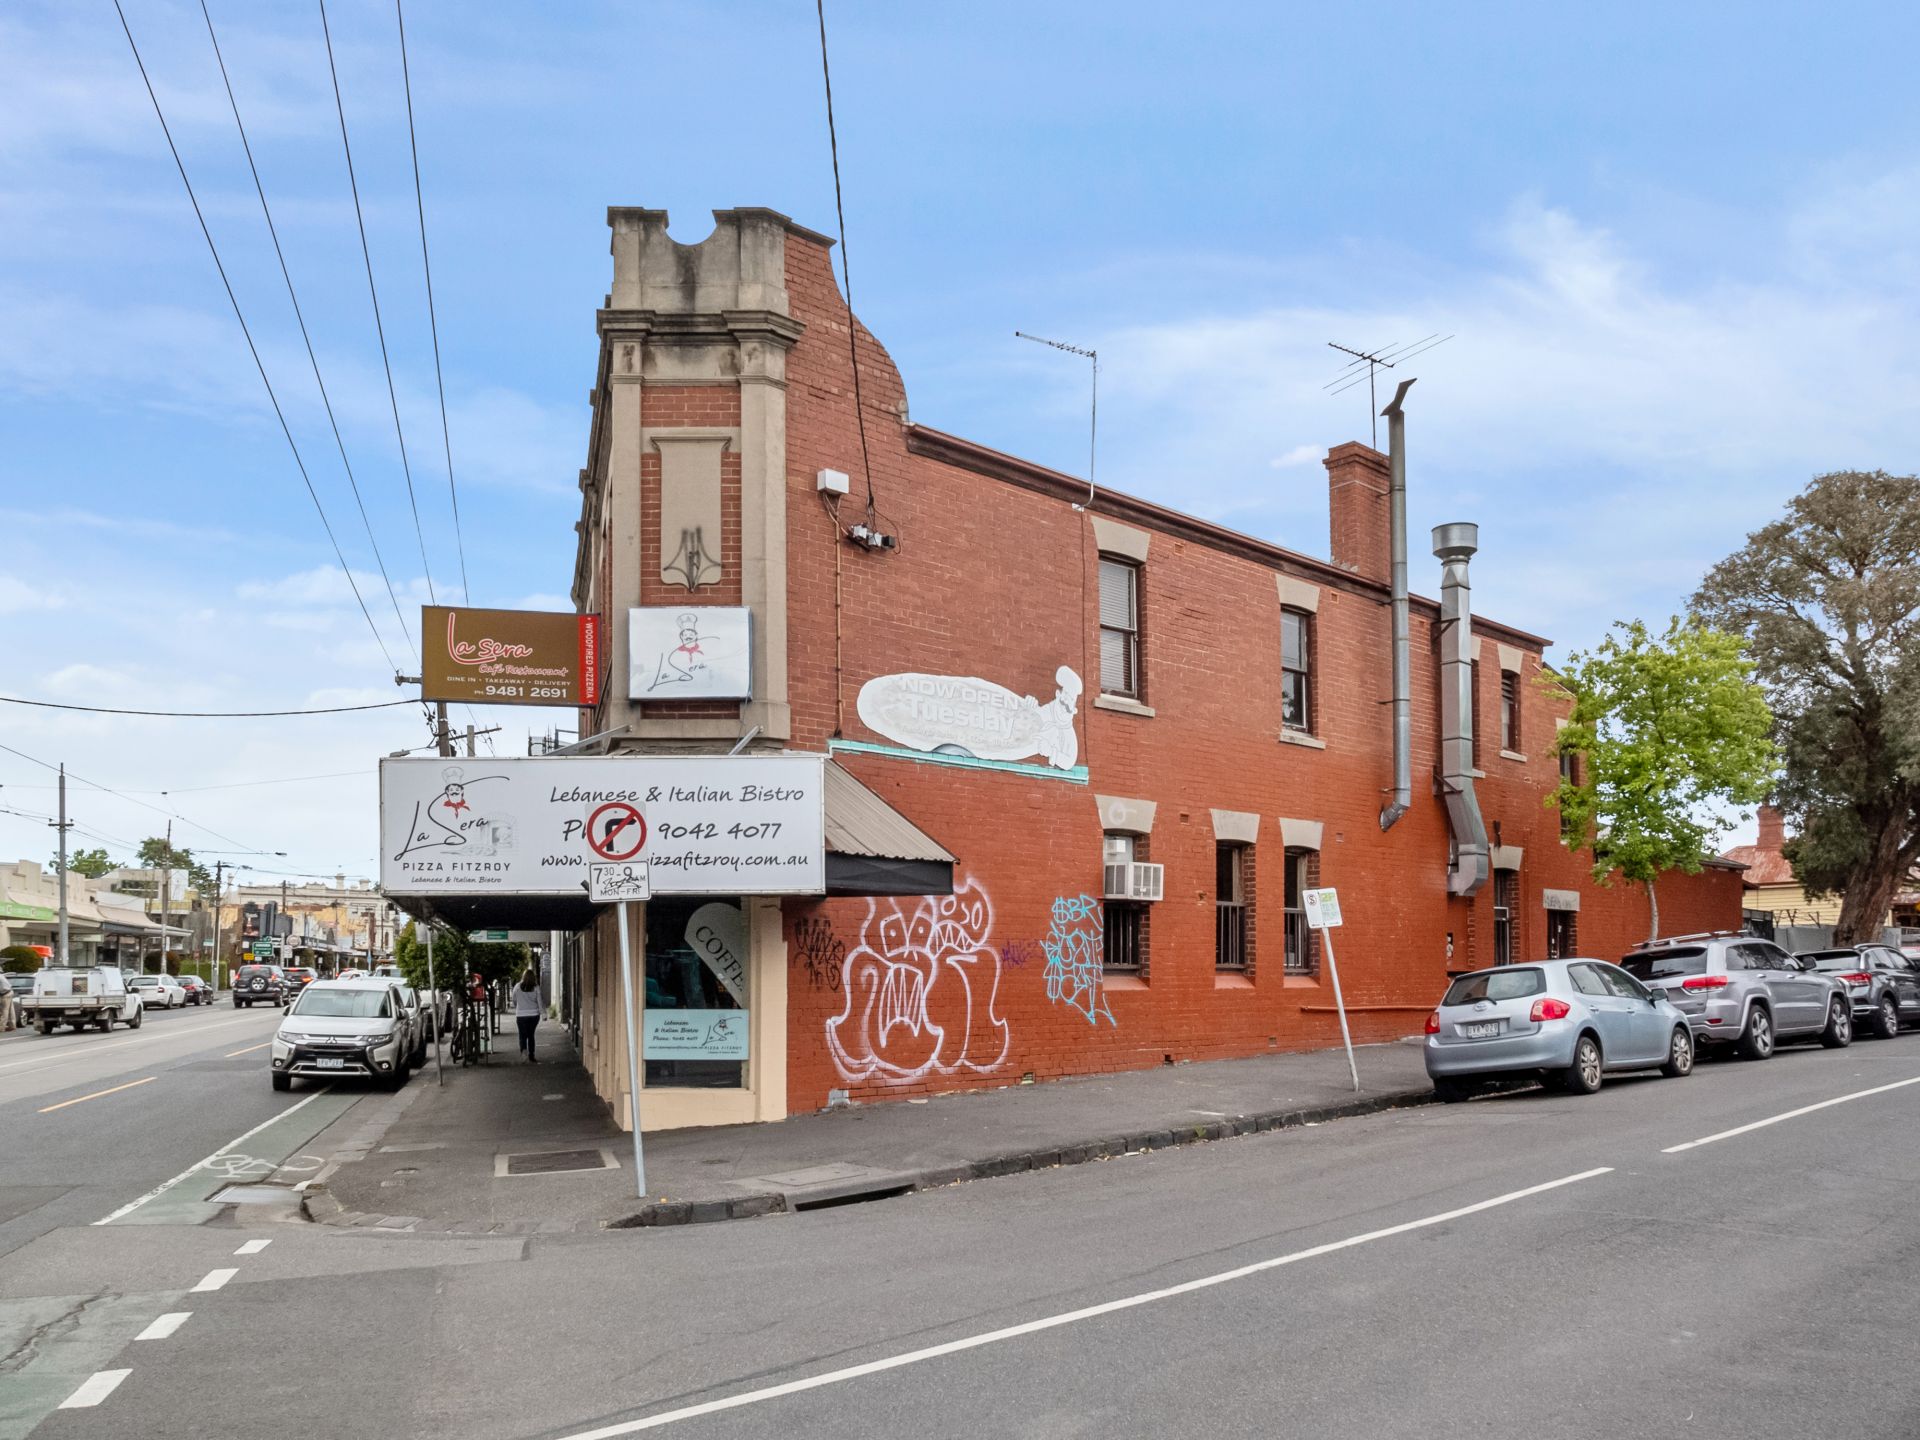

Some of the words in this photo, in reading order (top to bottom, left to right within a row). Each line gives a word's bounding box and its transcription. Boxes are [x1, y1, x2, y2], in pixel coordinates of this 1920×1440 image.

[448, 612, 496, 665] La
[478, 638, 533, 658] Sera
[585, 622, 594, 665] WOODFIRED
[485, 685, 524, 697] 9481
[530, 687, 567, 699] 2691
[585, 667, 594, 699] PIZZERIA
[902, 680, 957, 699] NOW
[961, 687, 1020, 710] OPEN
[906, 693, 1015, 741] Tuesday
[550, 786, 640, 802] Lebanese
[645, 786, 662, 802] &
[669, 785, 733, 802] Italian
[739, 784, 804, 802] Bistro
[428, 775, 510, 846] Sera
[658, 822, 719, 840] 9042
[727, 822, 782, 840] 4077
[402, 862, 444, 871] PIZZA
[452, 862, 511, 871] FITZROY
[695, 925, 745, 992] COFFE
